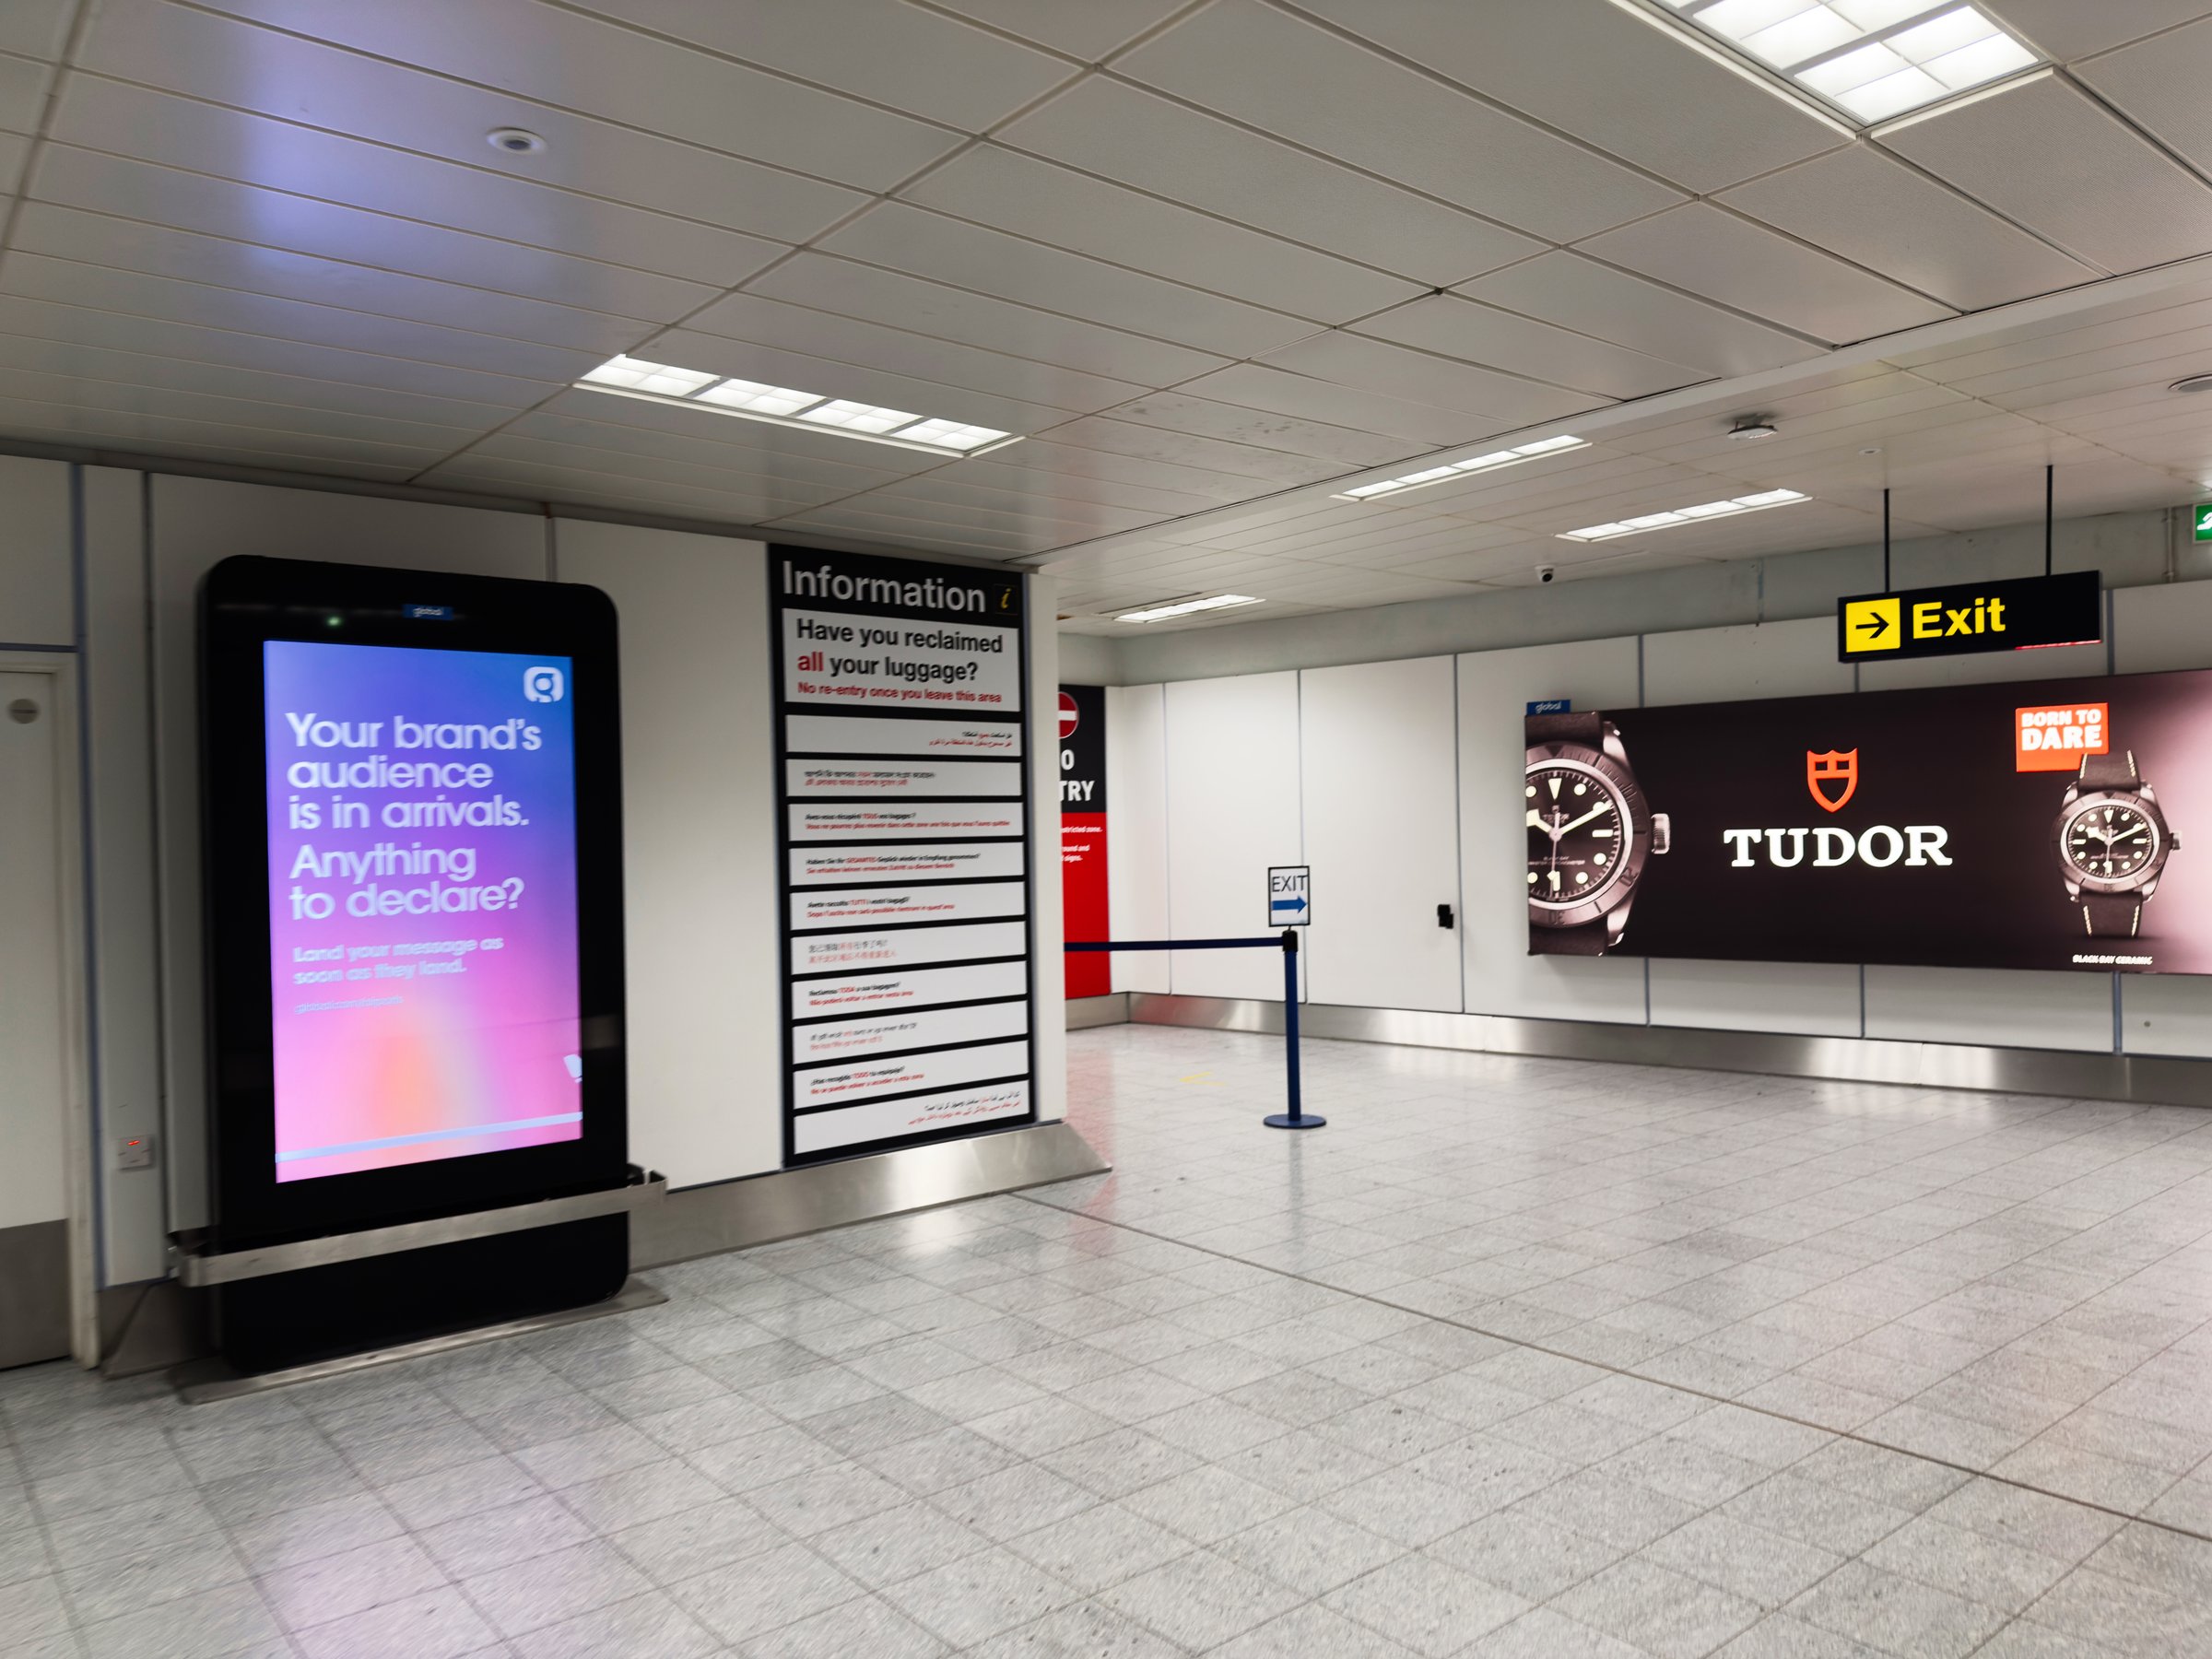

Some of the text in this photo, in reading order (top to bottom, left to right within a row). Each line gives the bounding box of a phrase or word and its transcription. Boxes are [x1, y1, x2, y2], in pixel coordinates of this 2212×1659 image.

[783, 561, 986, 612] Information
[1912, 597, 2006, 639] Exit
[796, 618, 1004, 653] Have you reclaimed
[797, 651, 978, 684] all your luggage?
[797, 681, 1002, 703] No re-entry once you leave this area
[285, 712, 542, 750] Your brand's
[2021, 709, 2101, 727] BORN TO
[2021, 724, 2102, 751] DARE
[288, 756, 494, 789] audience
[1061, 749, 1075, 771] O
[1060, 781, 1095, 802] TRY
[289, 794, 529, 830] is in arrivals.
[289, 841, 477, 884] Anything
[1724, 824, 1953, 868] TUDOR
[290, 877, 525, 920] to declare?
[1272, 875, 1308, 892] EXIT
[293, 937, 504, 963] Land your message as
[293, 958, 467, 985] soon as they land.
